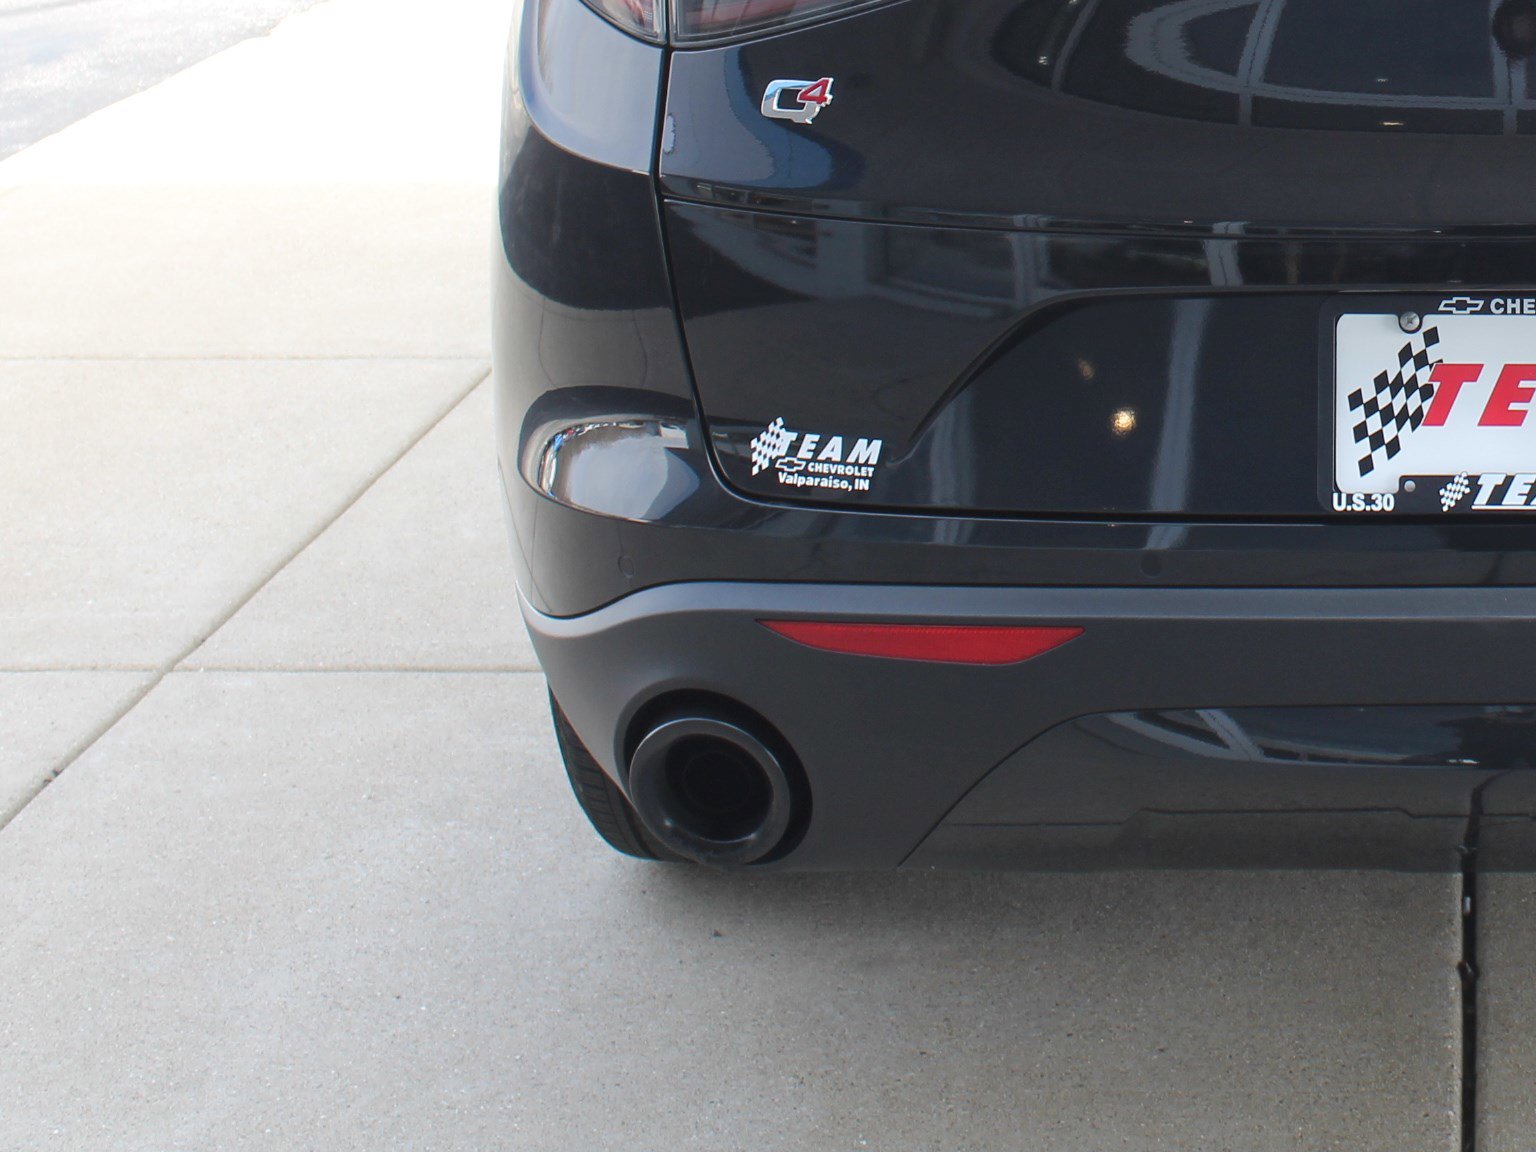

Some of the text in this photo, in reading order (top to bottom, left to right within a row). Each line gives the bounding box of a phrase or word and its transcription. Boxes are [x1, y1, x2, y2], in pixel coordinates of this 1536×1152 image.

[761, 77, 834, 124] Q4
[777, 431, 882, 465] TEAM
[808, 461, 875, 477] CHEVROLET
[778, 471, 870, 491] Valparaiso, IN
[1332, 493, 1395, 513] U.S.30
